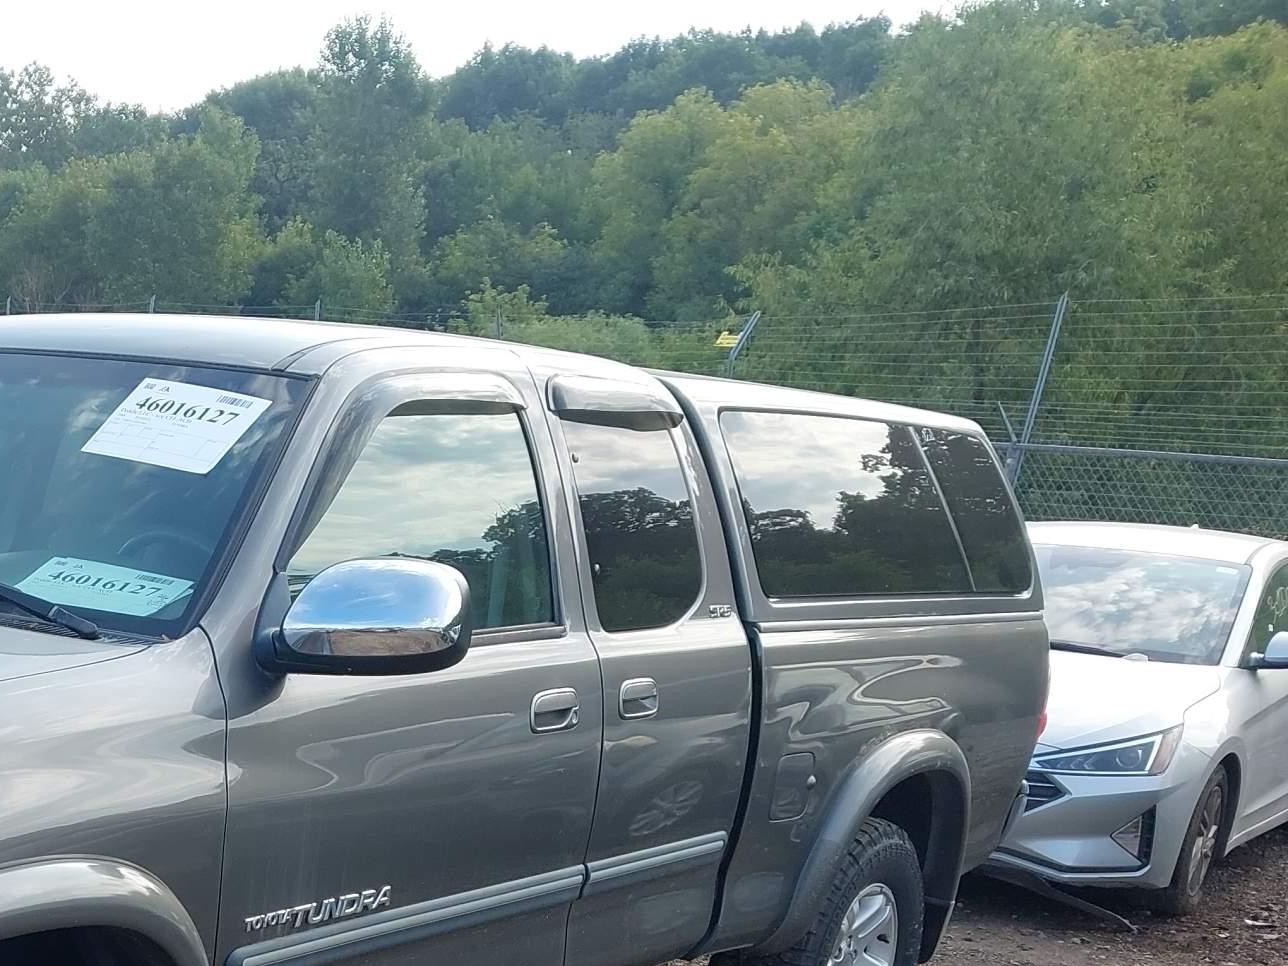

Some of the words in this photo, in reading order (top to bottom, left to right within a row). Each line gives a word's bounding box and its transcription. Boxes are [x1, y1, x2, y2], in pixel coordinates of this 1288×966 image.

[136, 396, 240, 426] 46016127
[48, 570, 161, 597] 46016127
[244, 907, 293, 933] TOYOTA
[292, 884, 392, 928] TUNDRA
